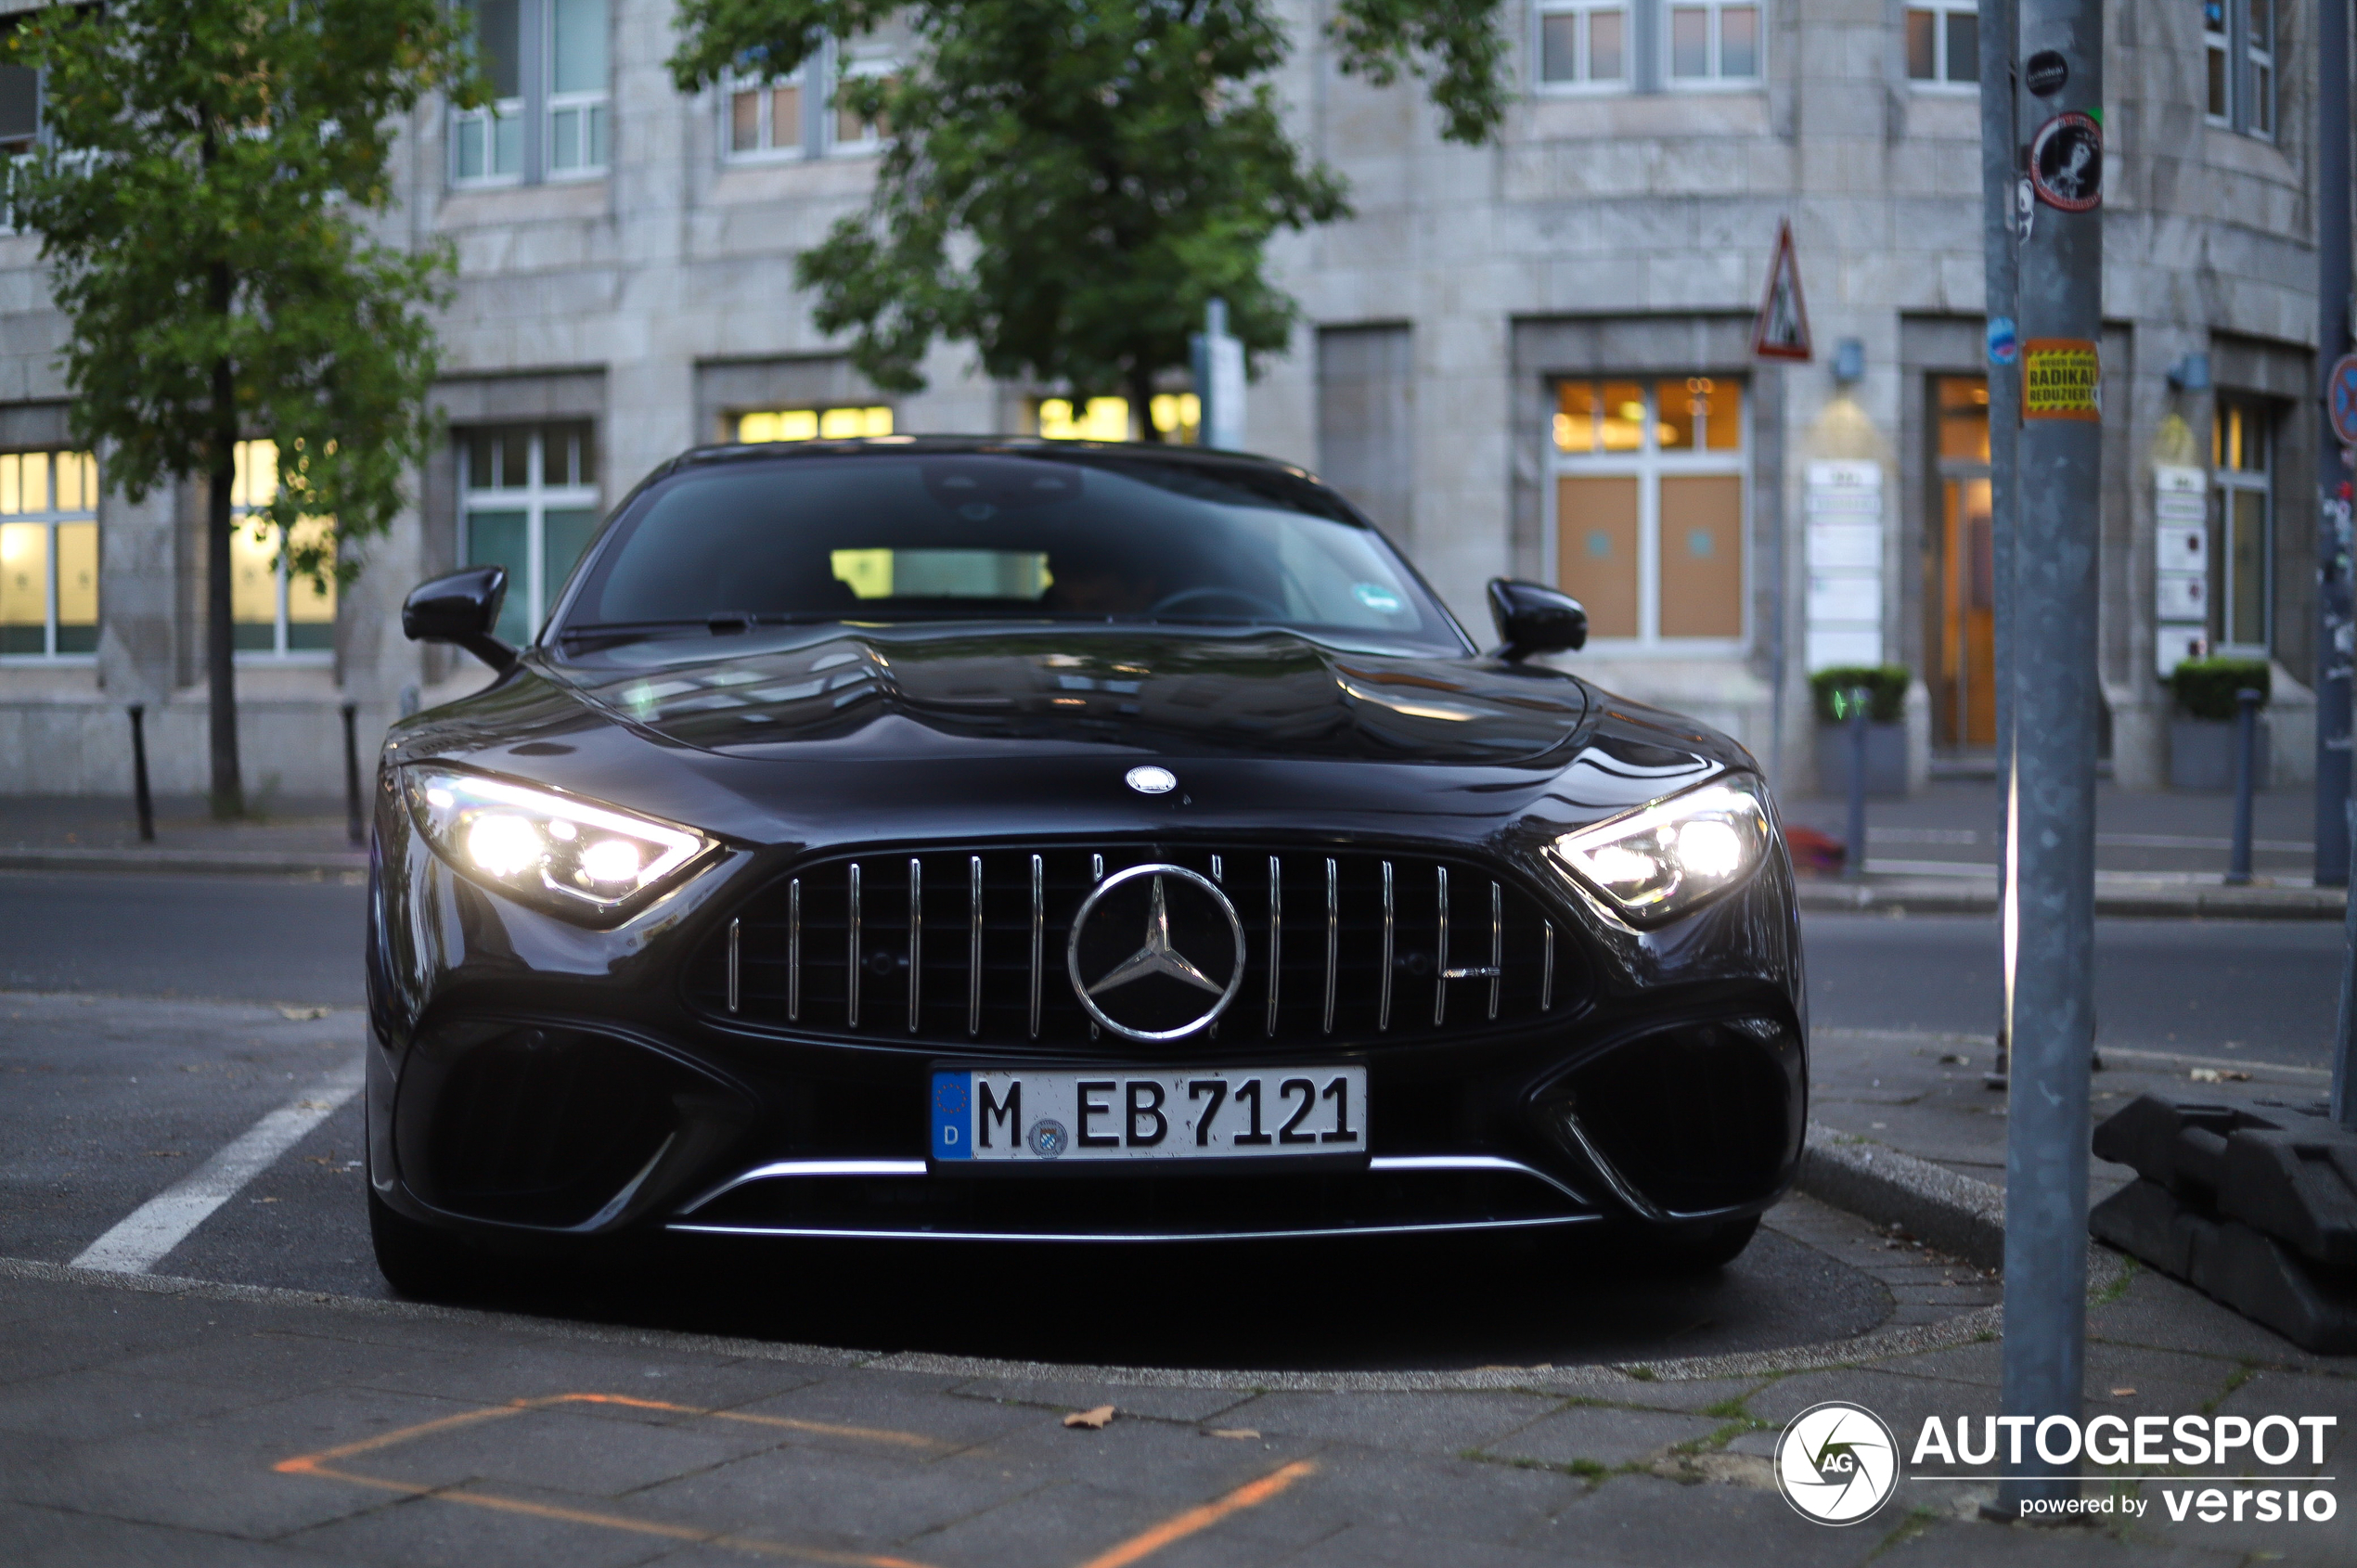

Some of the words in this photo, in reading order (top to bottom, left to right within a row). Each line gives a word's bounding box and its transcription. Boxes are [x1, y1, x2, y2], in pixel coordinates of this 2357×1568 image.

[943, 1125, 960, 1145] D
[978, 1079, 1022, 1149] M
[1077, 1079, 1168, 1148] EB
[1188, 1077, 1358, 1147] 7121
